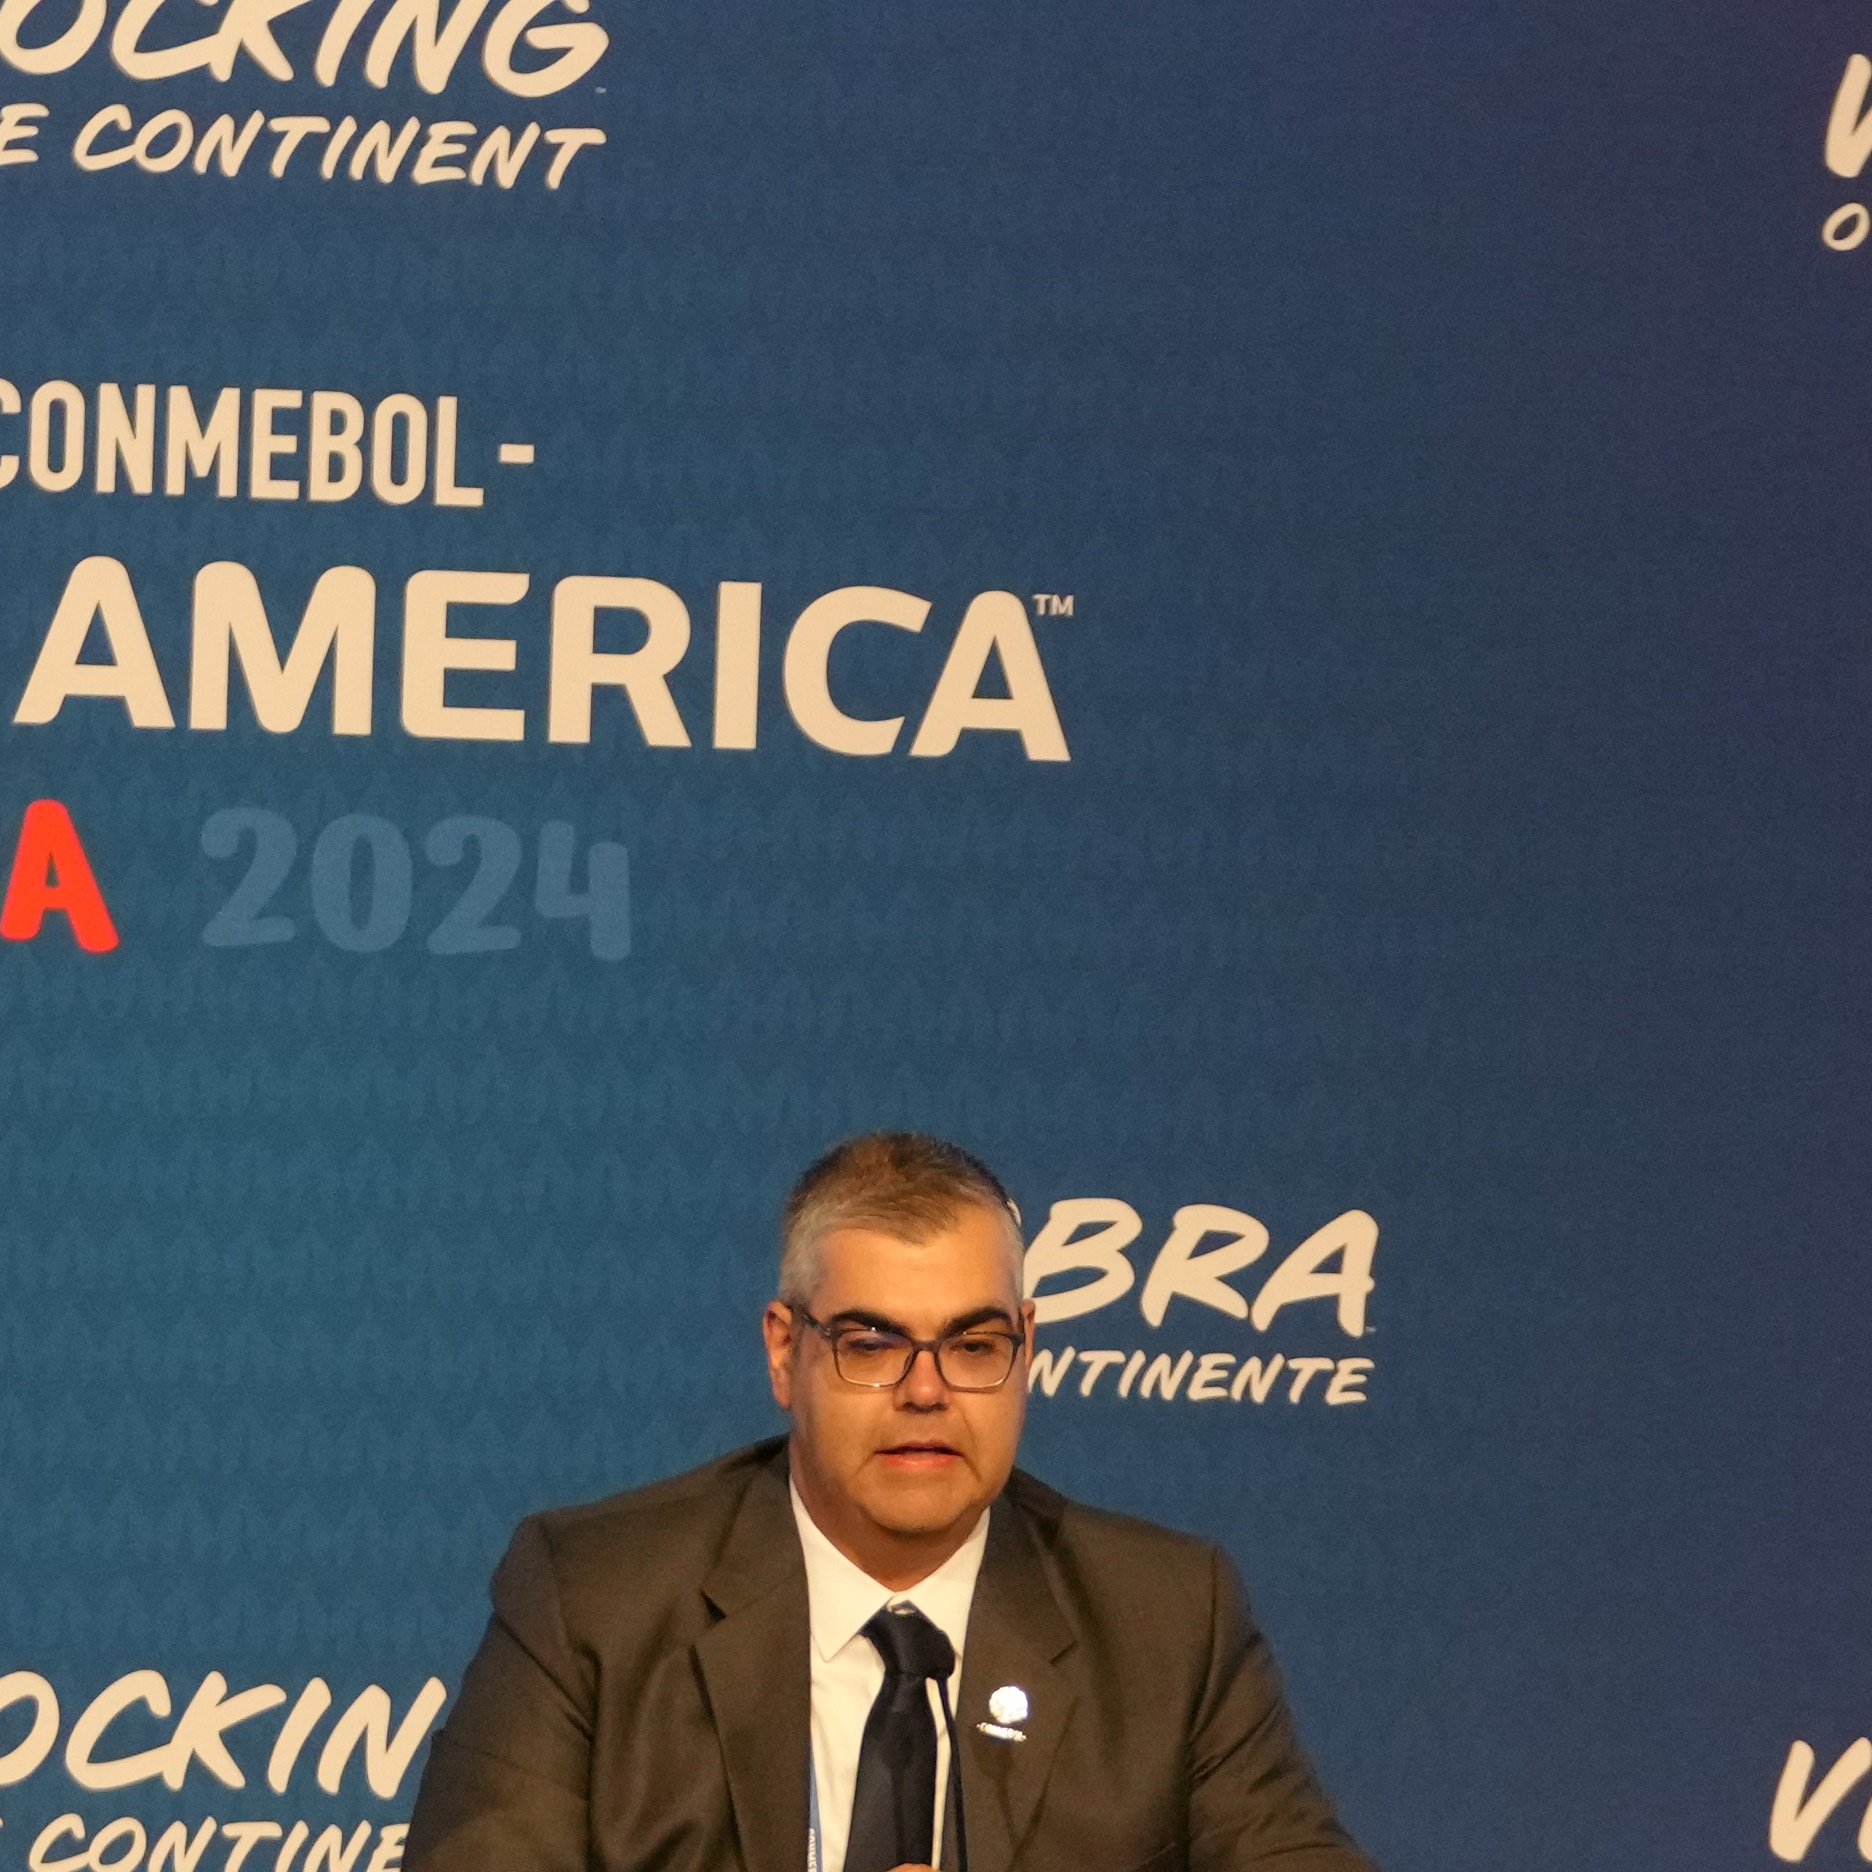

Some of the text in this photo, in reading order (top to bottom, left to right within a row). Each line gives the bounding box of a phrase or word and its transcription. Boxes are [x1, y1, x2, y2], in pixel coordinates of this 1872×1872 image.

[72, 104, 607, 190] CONTINENT
[1822, 202, 1871, 252] O
[14, 555, 1073, 763] AMERICA
[199, 806, 632, 960] 2024
[1028, 1344, 1376, 1406] NTINENTE
